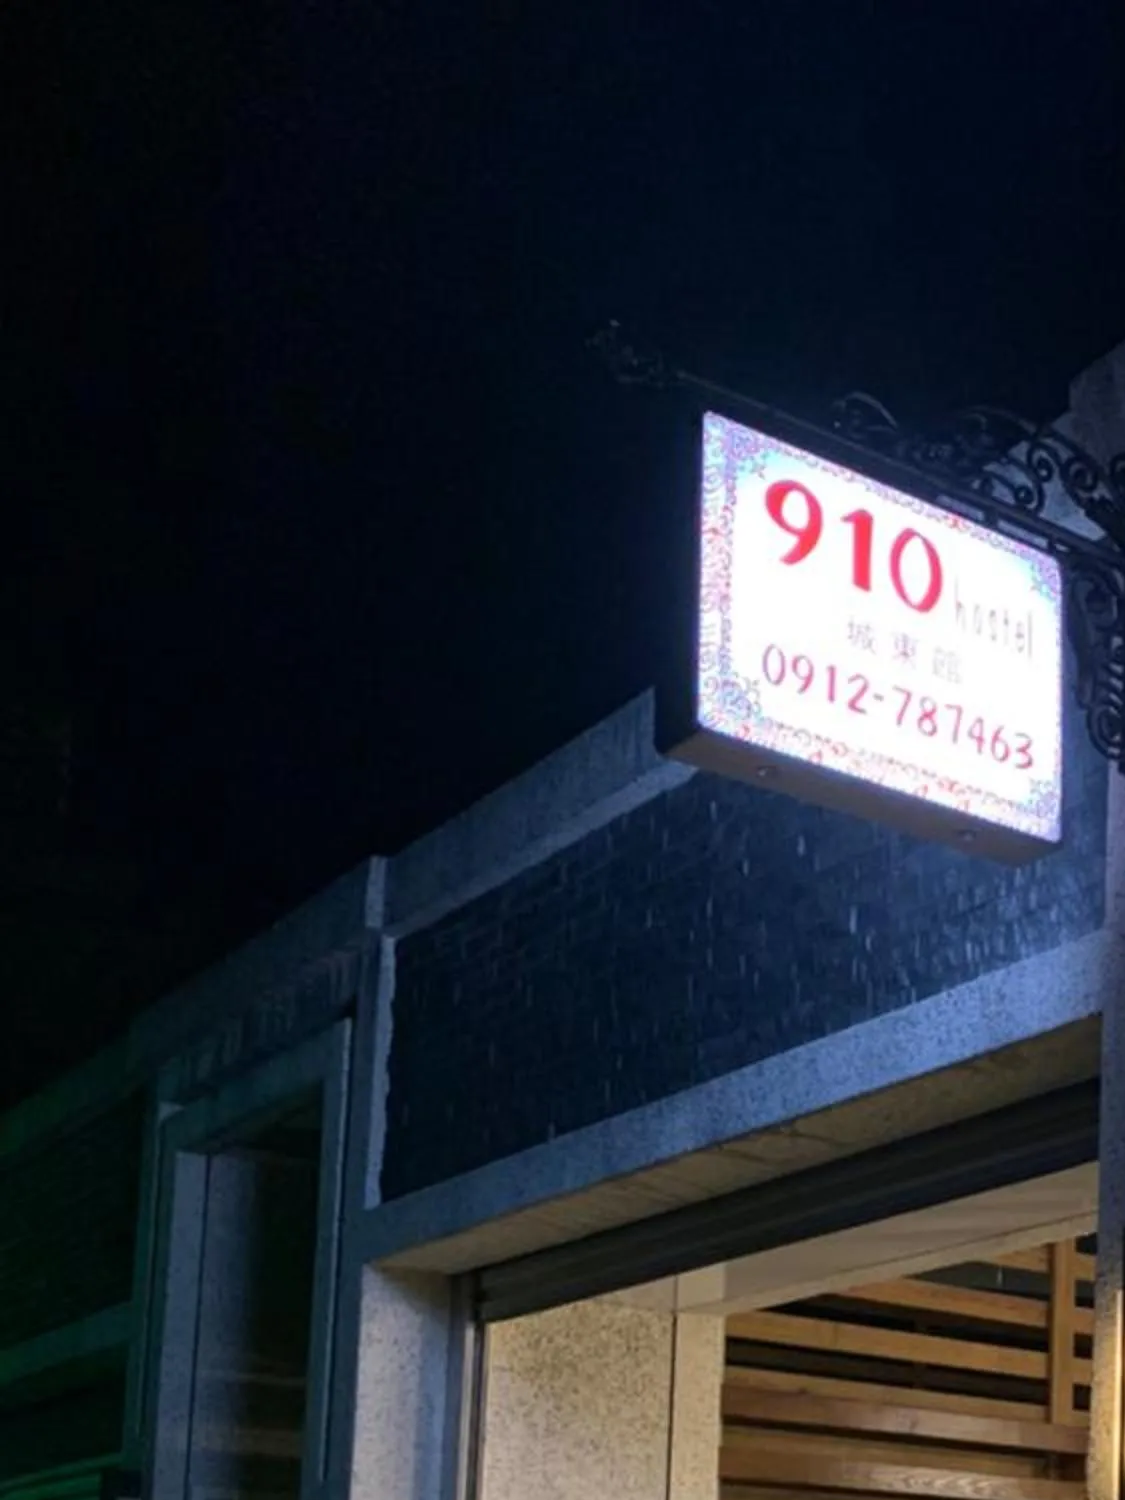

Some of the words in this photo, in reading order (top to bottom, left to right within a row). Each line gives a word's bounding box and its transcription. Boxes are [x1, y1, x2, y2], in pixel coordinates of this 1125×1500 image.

[764, 479, 944, 614] 910
[954, 575, 1034, 660] hostel
[762, 643, 1035, 771] 0912-787463
